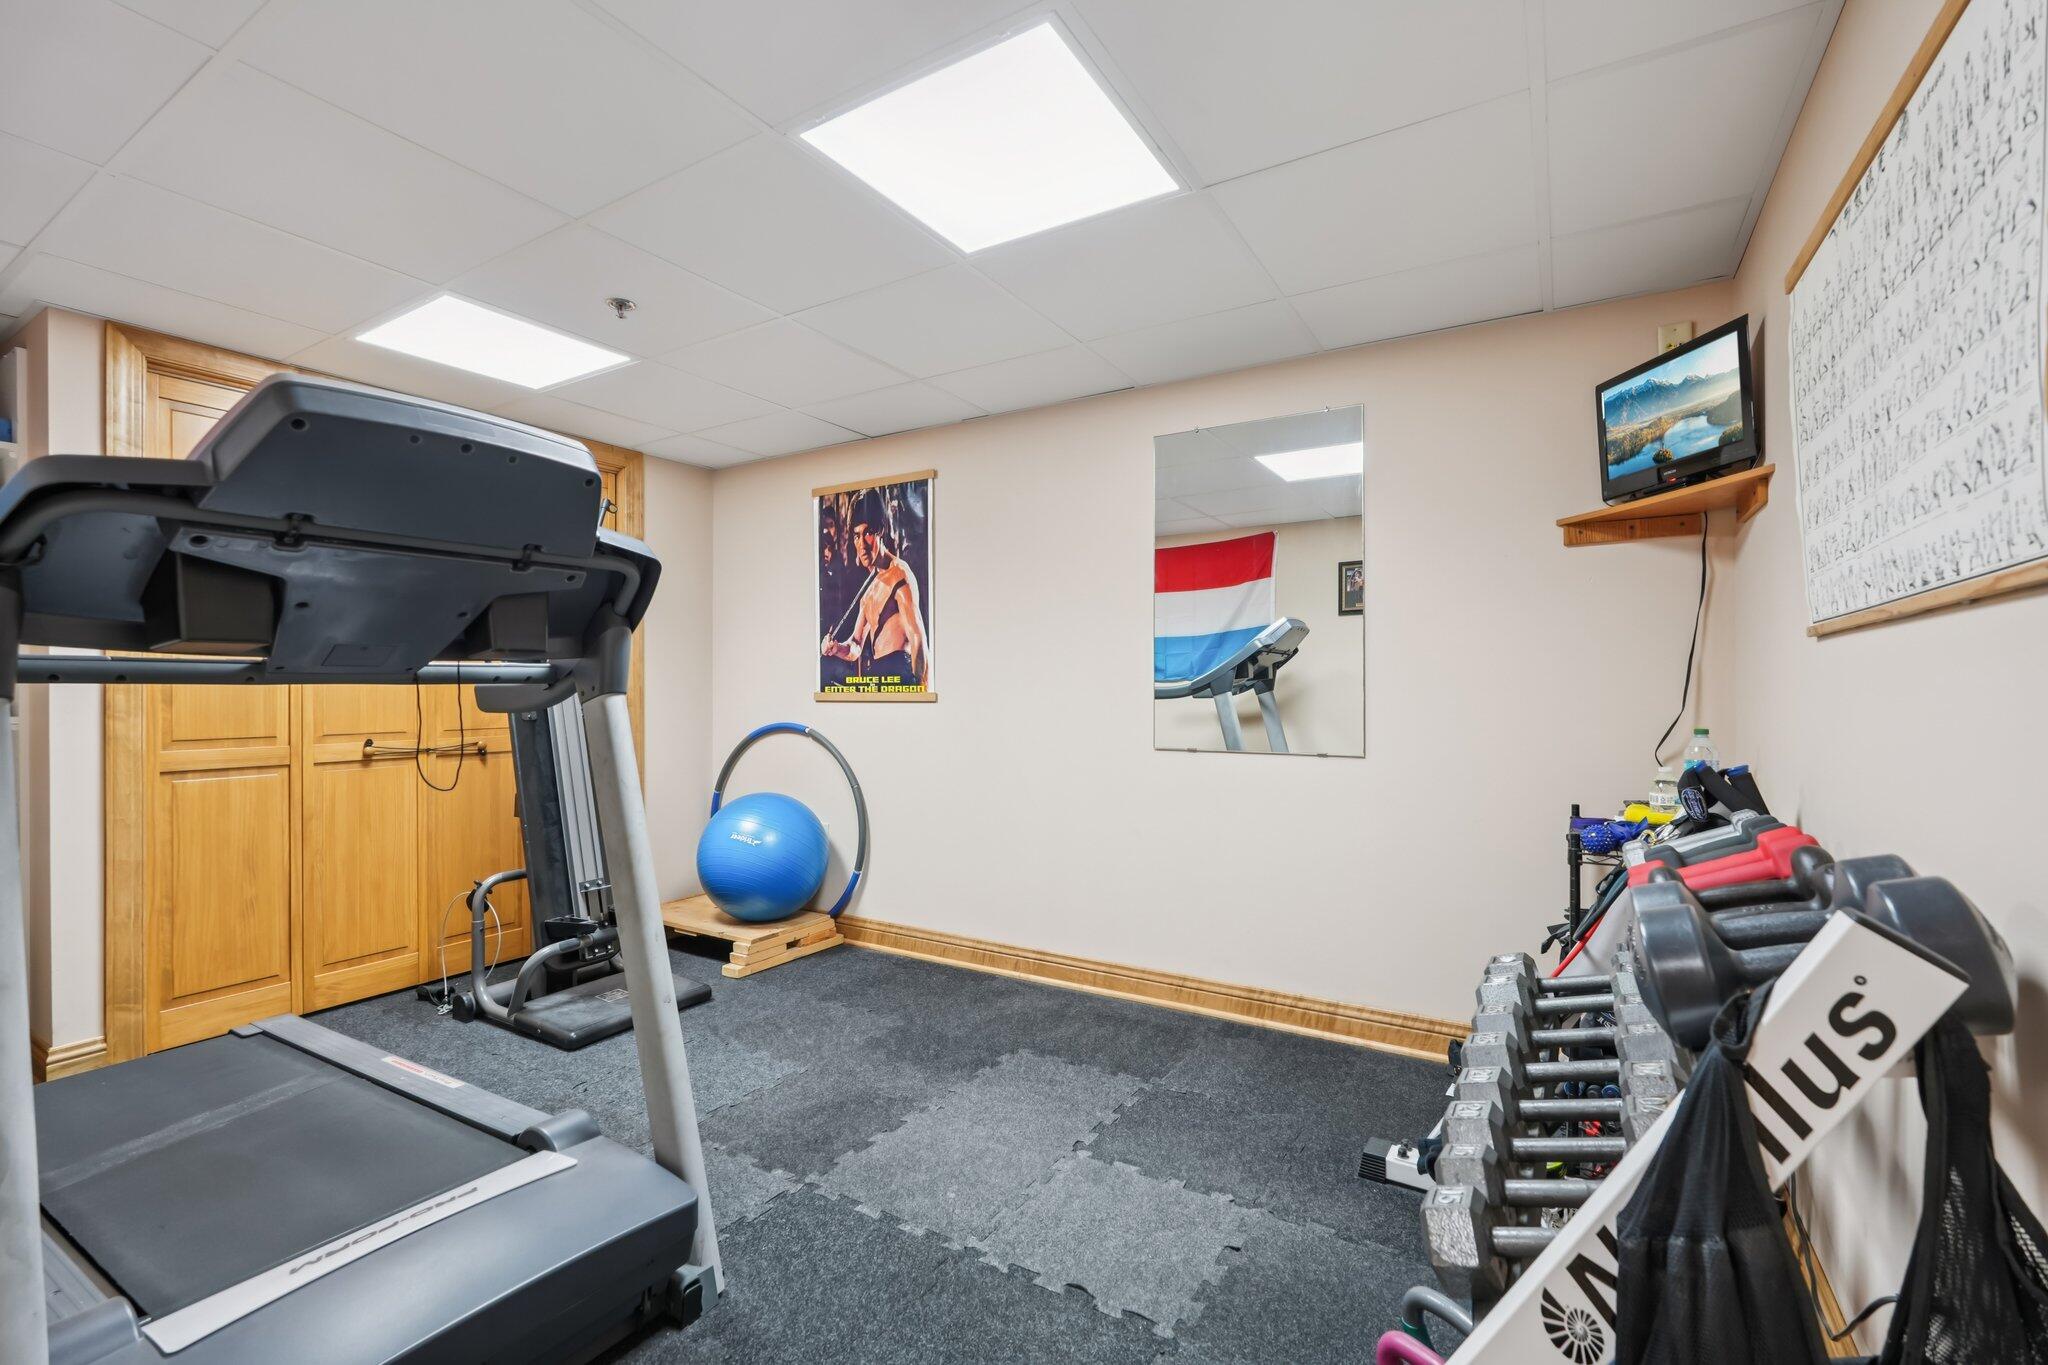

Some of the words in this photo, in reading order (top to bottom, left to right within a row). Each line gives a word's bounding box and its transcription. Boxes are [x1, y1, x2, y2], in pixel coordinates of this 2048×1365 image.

[846, 676, 879, 684] BRUCE
[881, 675, 901, 683] LEE
[880, 685, 925, 693] DRAGON
